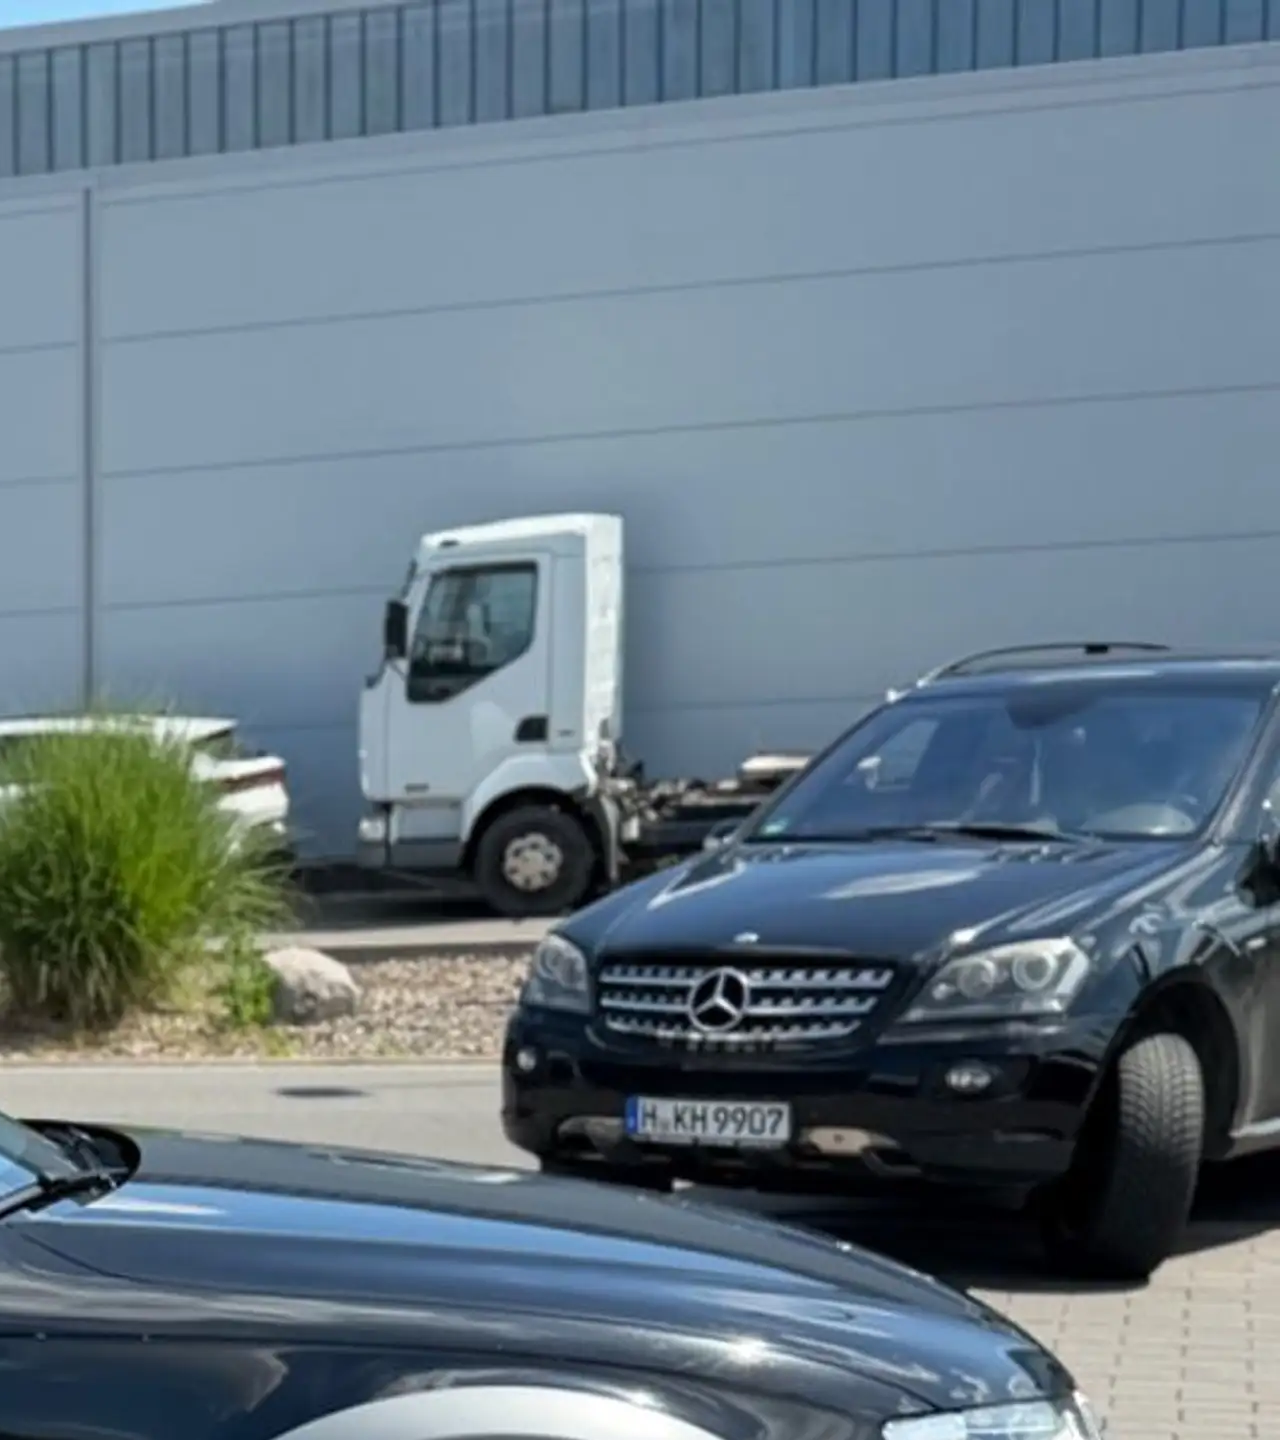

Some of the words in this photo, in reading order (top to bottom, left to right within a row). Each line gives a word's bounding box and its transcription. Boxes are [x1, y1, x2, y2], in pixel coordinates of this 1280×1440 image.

[642, 1103, 657, 1128] H
[674, 1104, 708, 1131] KH
[713, 1106, 784, 1136] 9907
